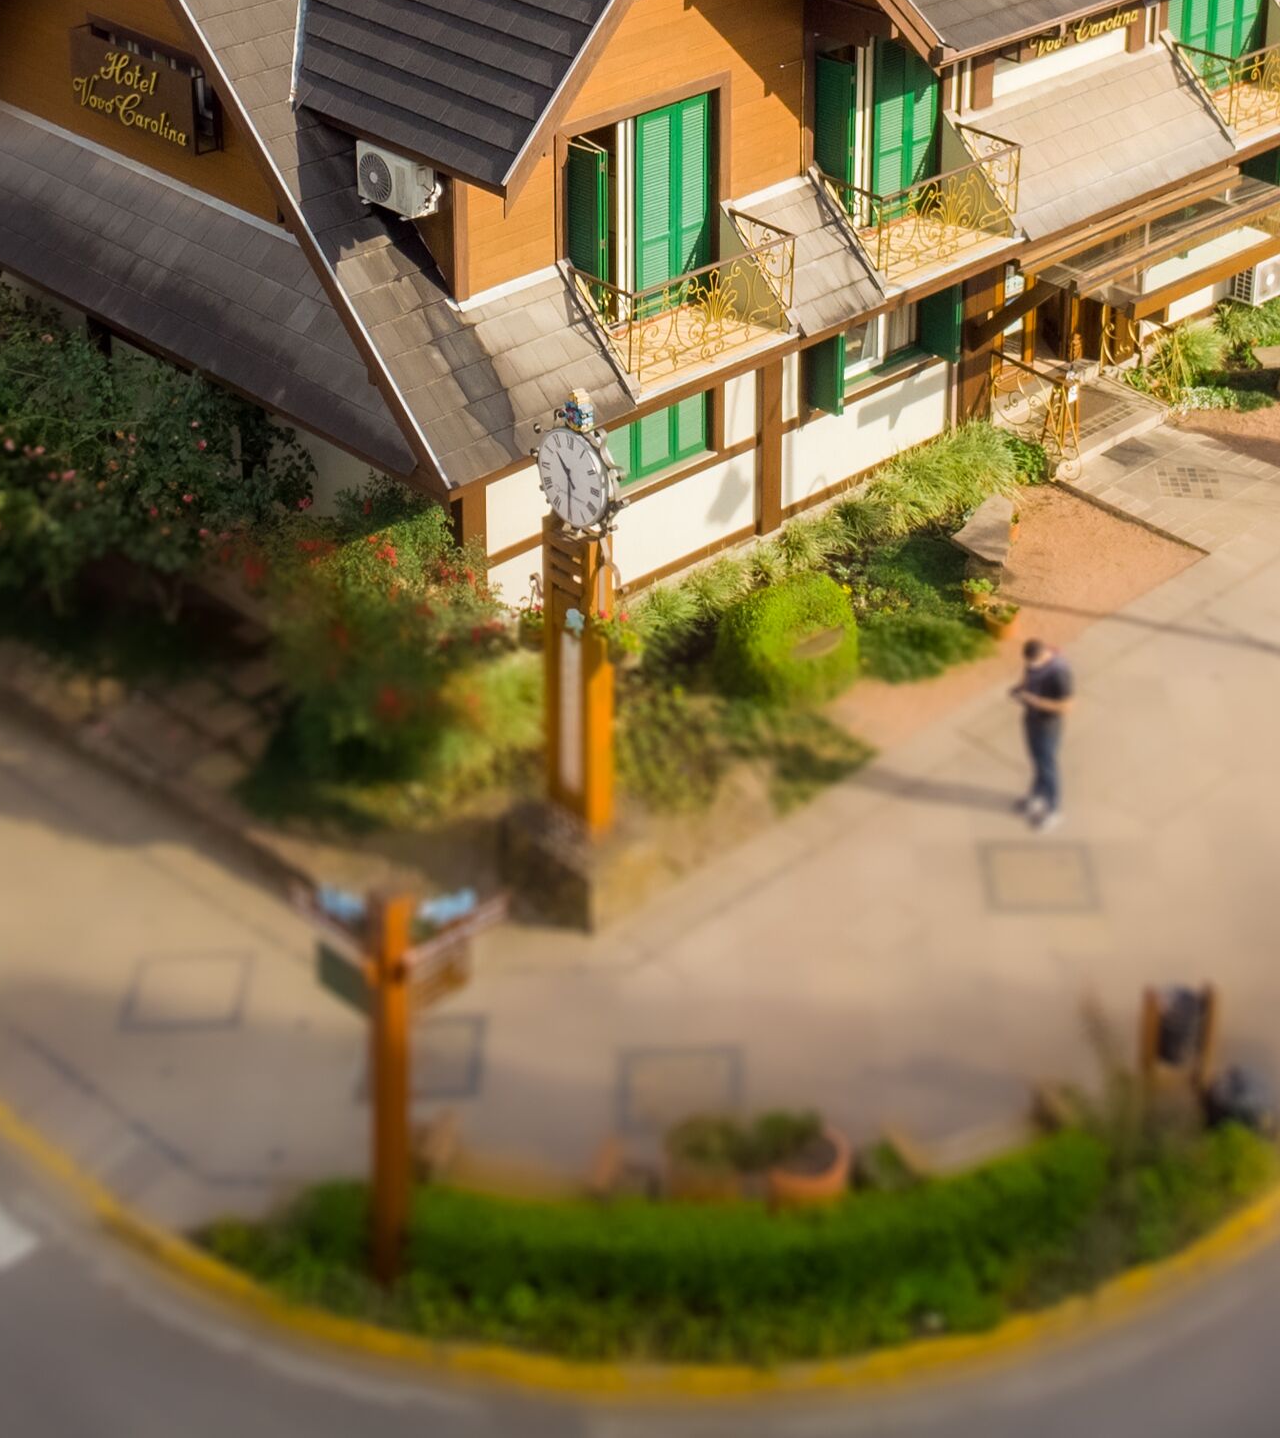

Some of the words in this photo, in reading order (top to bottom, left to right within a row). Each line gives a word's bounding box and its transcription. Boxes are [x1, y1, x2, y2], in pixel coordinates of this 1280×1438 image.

[1073, 7, 1139, 42] Carolina
[100, 52, 157, 95] Hotel
[73, 75, 114, 113] Vovó
[115, 94, 186, 146] Carolina
